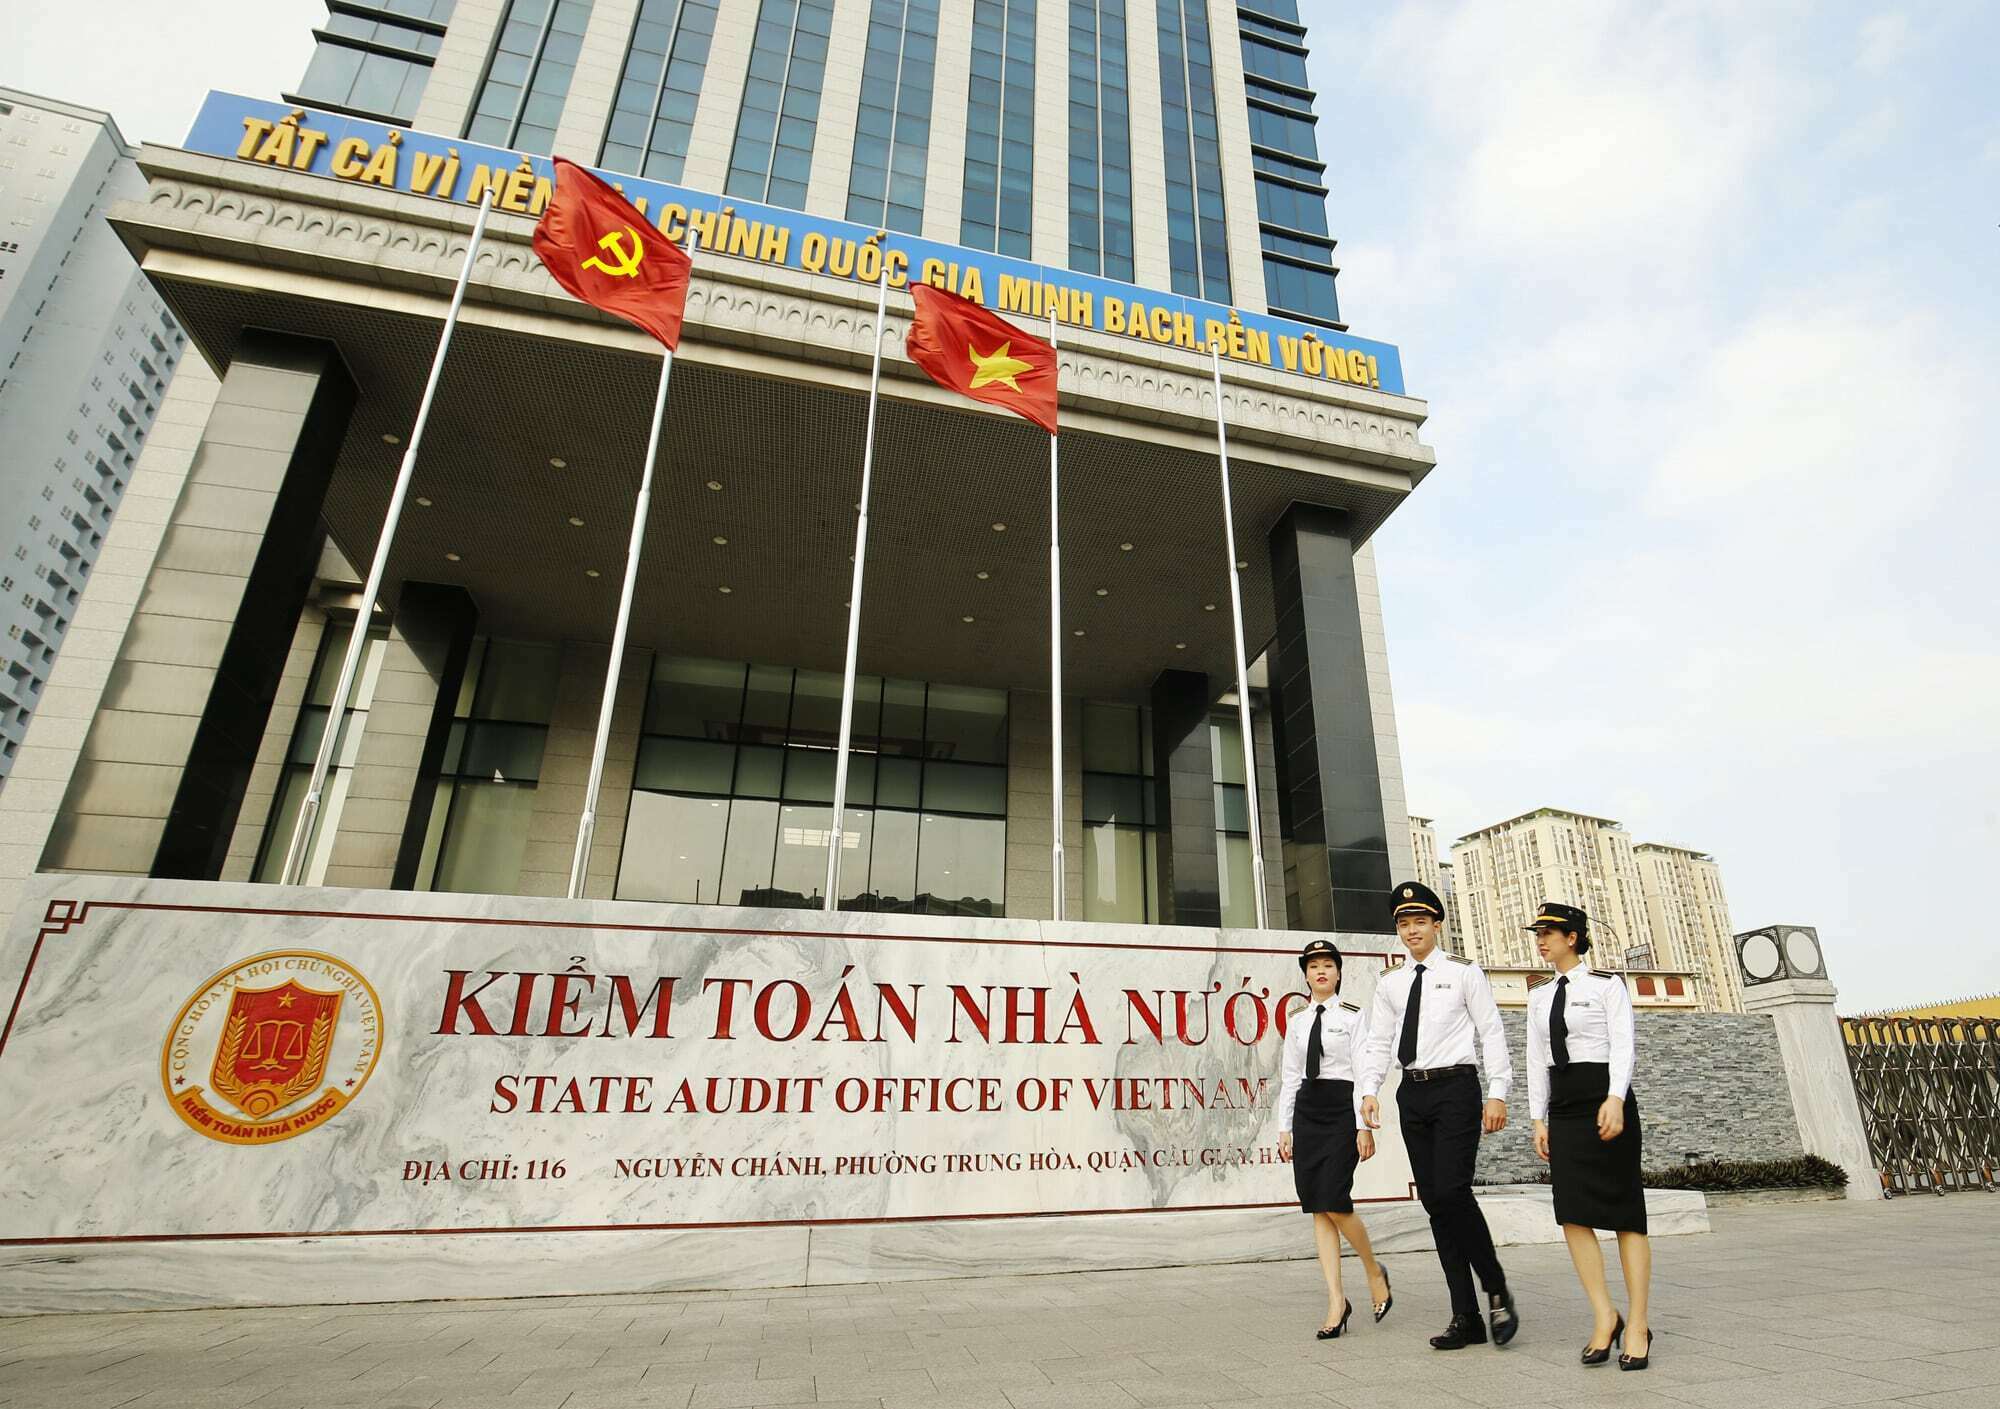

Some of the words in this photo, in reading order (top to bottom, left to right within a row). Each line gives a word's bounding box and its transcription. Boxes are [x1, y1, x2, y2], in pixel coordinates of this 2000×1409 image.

[236, 108, 328, 172] TẤT
[331, 130, 403, 188] CẢ
[411, 148, 461, 198] VÌ
[656, 203, 790, 264] CHÍNH
[801, 230, 908, 288] QUỐC
[922, 258, 985, 305] GIA
[999, 273, 1093, 327] MINH
[1278, 332, 1380, 389] VỮNG!
[430, 956, 681, 1039] KIỂM
[703, 965, 924, 1042] TOÁN
[945, 972, 1100, 1045] NHÀ
[1122, 977, 1312, 1047] NƯỚC
[354, 1038, 374, 1074] NAM
[490, 1075, 653, 1114] STATE
[664, 1077, 824, 1113] AUDIT
[834, 1077, 1002, 1113] OFFICE
[1016, 1077, 1073, 1112] OF
[1082, 1077, 1271, 1111] VIETNAM
[401, 1160, 451, 1186] ĐỊA
[460, 1153, 518, 1180] CHỈ:
[526, 1159, 567, 1179] 116
[614, 1152, 725, 1178] NGUYỄN
[732, 1151, 827, 1177] CHÁNH,
[834, 1150, 936, 1175] PHƯỜNG
[943, 1152, 1021, 1173] TRUNG
[1029, 1147, 1082, 1172] HÒA,
[1087, 1148, 1147, 1173] QUẬN
